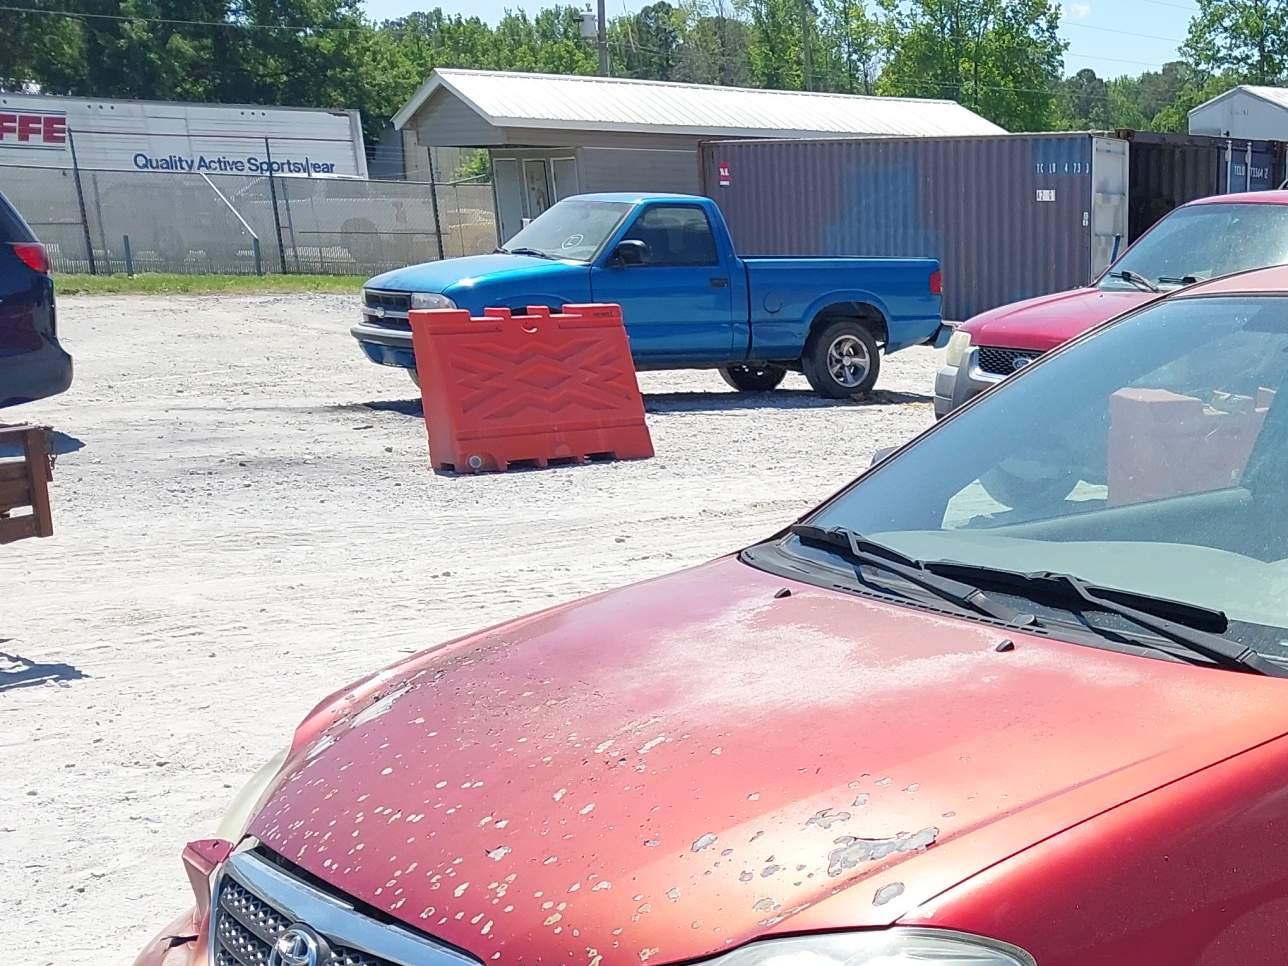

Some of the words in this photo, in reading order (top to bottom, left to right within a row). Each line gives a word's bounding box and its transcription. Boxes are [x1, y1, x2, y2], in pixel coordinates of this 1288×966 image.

[0, 114, 66, 143] FFE
[133, 153, 194, 171] Quality
[197, 155, 245, 171] Active
[247, 157, 335, 174] Sportswear
